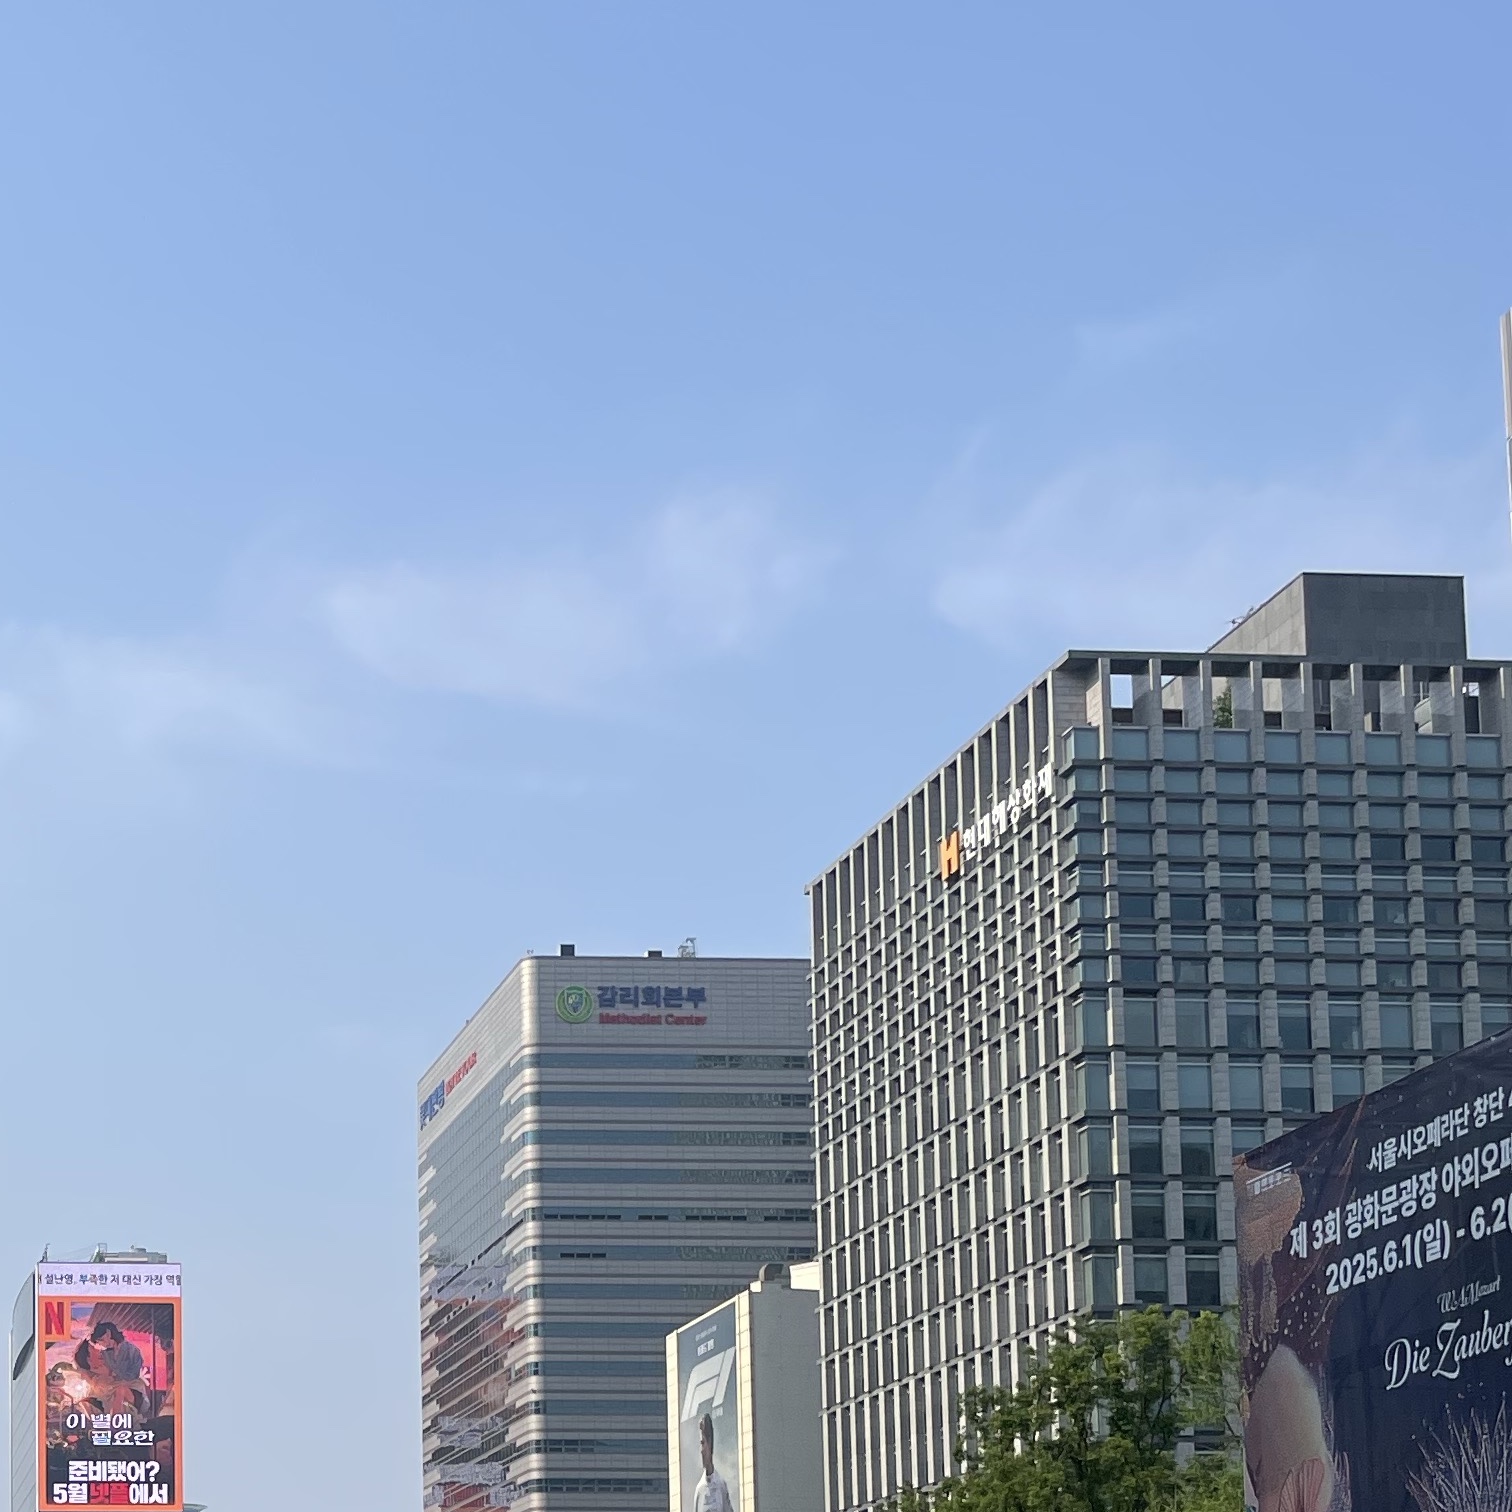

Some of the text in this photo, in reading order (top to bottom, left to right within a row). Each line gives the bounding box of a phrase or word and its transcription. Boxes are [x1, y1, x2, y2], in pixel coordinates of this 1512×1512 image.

[597, 984, 707, 1009] 감리회본부
[665, 1013, 707, 1026] Center
[1365, 1086, 1505, 1173] 서울시오페라단 창단
[1289, 1220, 1308, 1259] 제
[1311, 1206, 1342, 1251] 3회
[1344, 1166, 1439, 1240] 광화문광장
[1325, 1218, 1451, 1295] 2025.6.1(일)
[110, 1274, 120, 1286] 저
[122, 1274, 142, 1286] 대신
[44, 1301, 65, 1336] N
[1384, 1309, 1512, 1391] Die Zauber
[66, 1413, 86, 1429] 이
[68, 1460, 161, 1483] 준비됐어?
[52, 1483, 88, 1504] 5월
